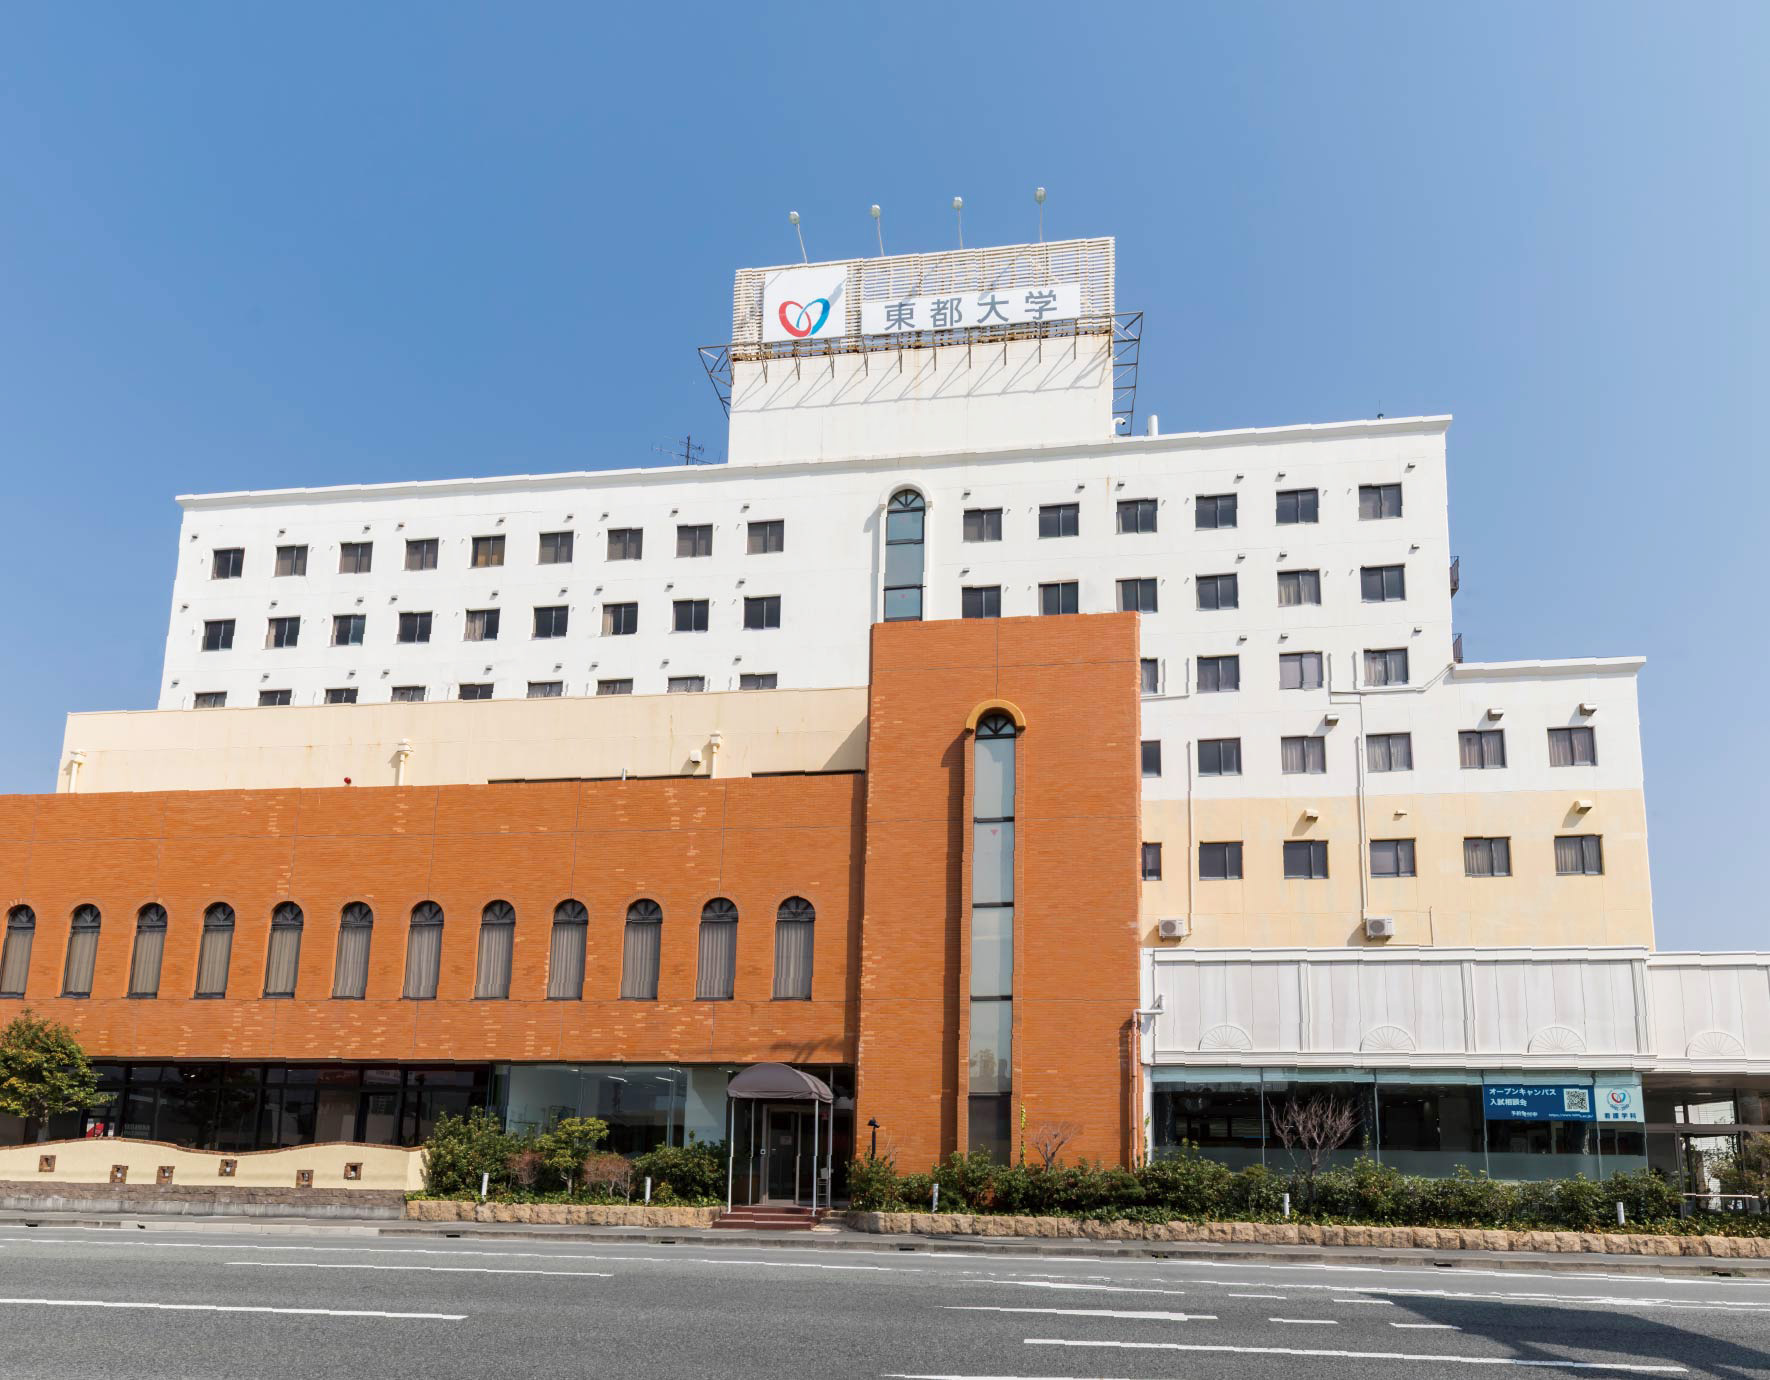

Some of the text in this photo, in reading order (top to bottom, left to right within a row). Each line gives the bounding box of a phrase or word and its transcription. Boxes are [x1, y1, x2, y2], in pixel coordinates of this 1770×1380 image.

[884, 289, 1057, 331] 東都大学
[1489, 1088, 1557, 1096] オープンキャンパス
